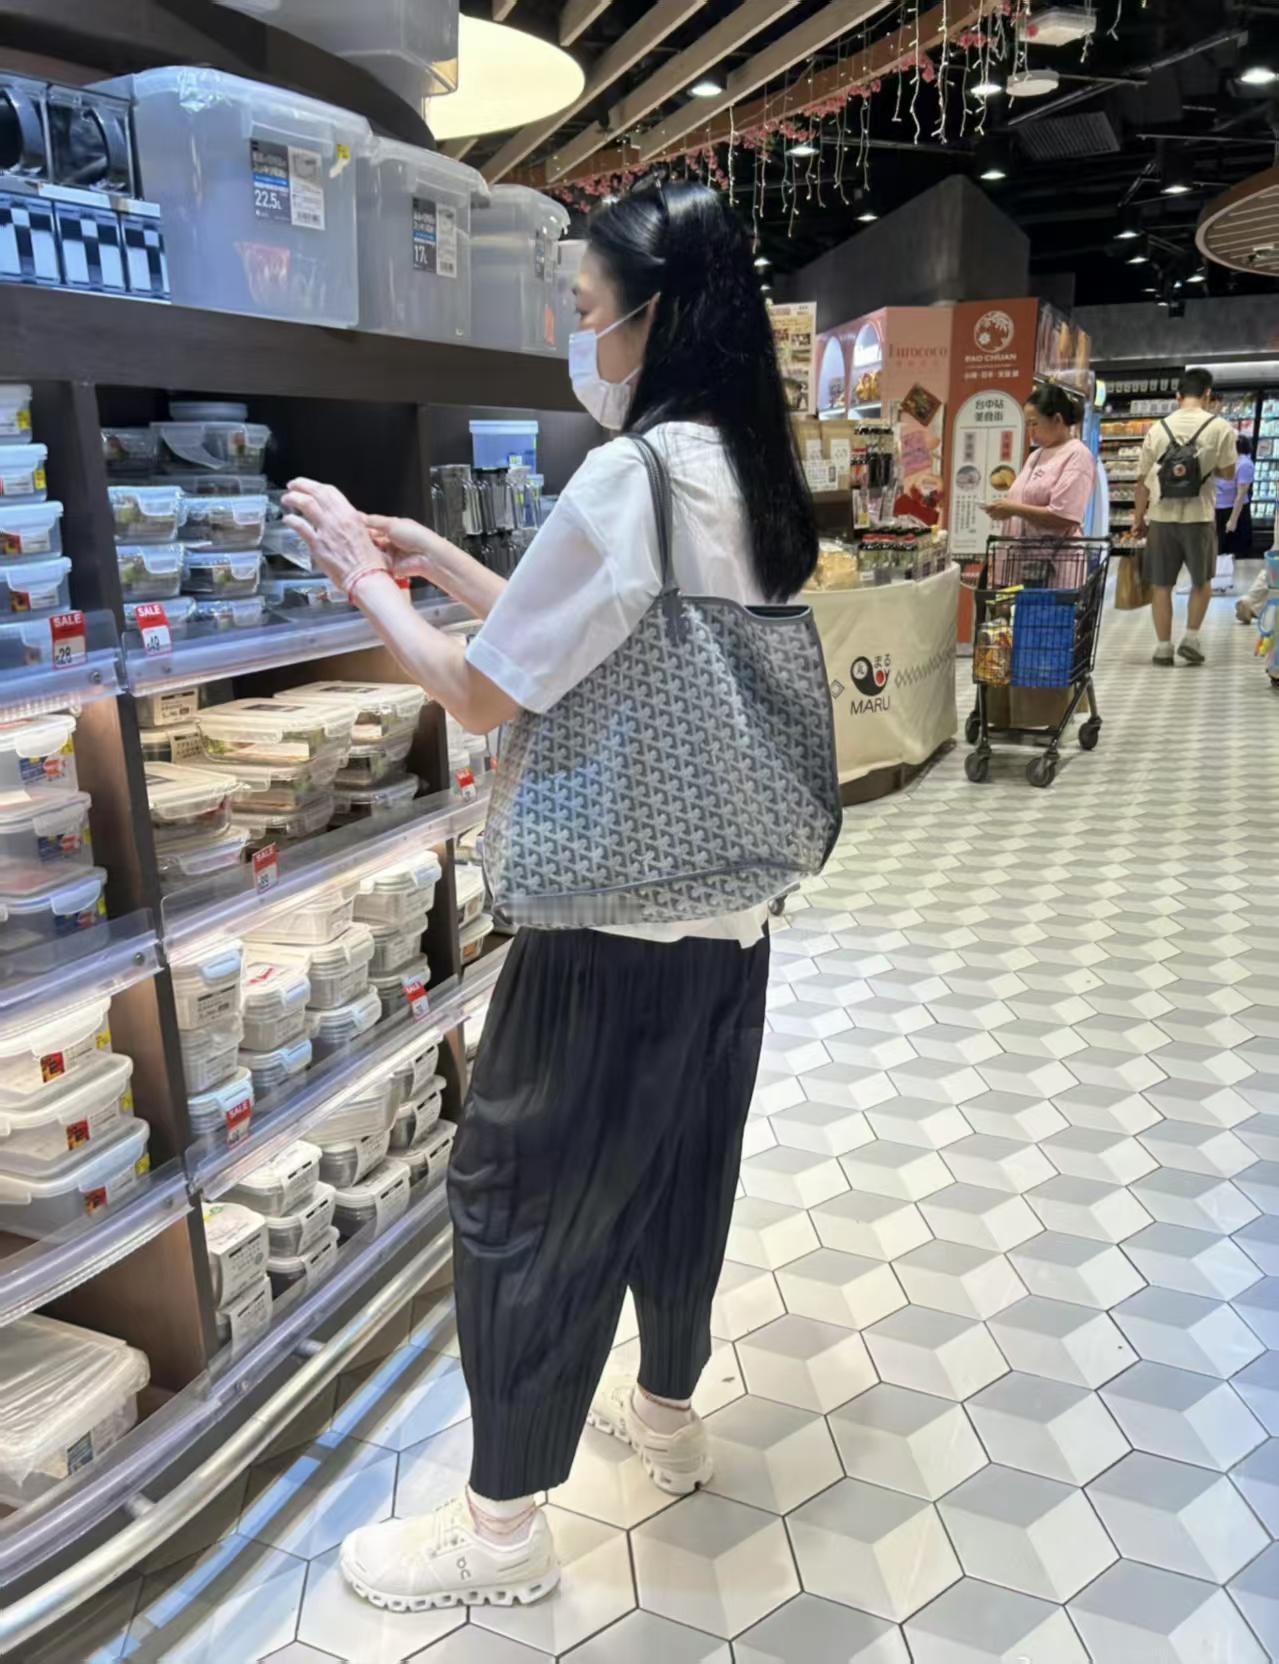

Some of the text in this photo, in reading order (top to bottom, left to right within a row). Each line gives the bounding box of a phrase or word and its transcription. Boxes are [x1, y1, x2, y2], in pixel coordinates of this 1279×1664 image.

[137, 604, 161, 616] SALE
[54, 613, 82, 627] SALE
[850, 695, 891, 716] MARU
